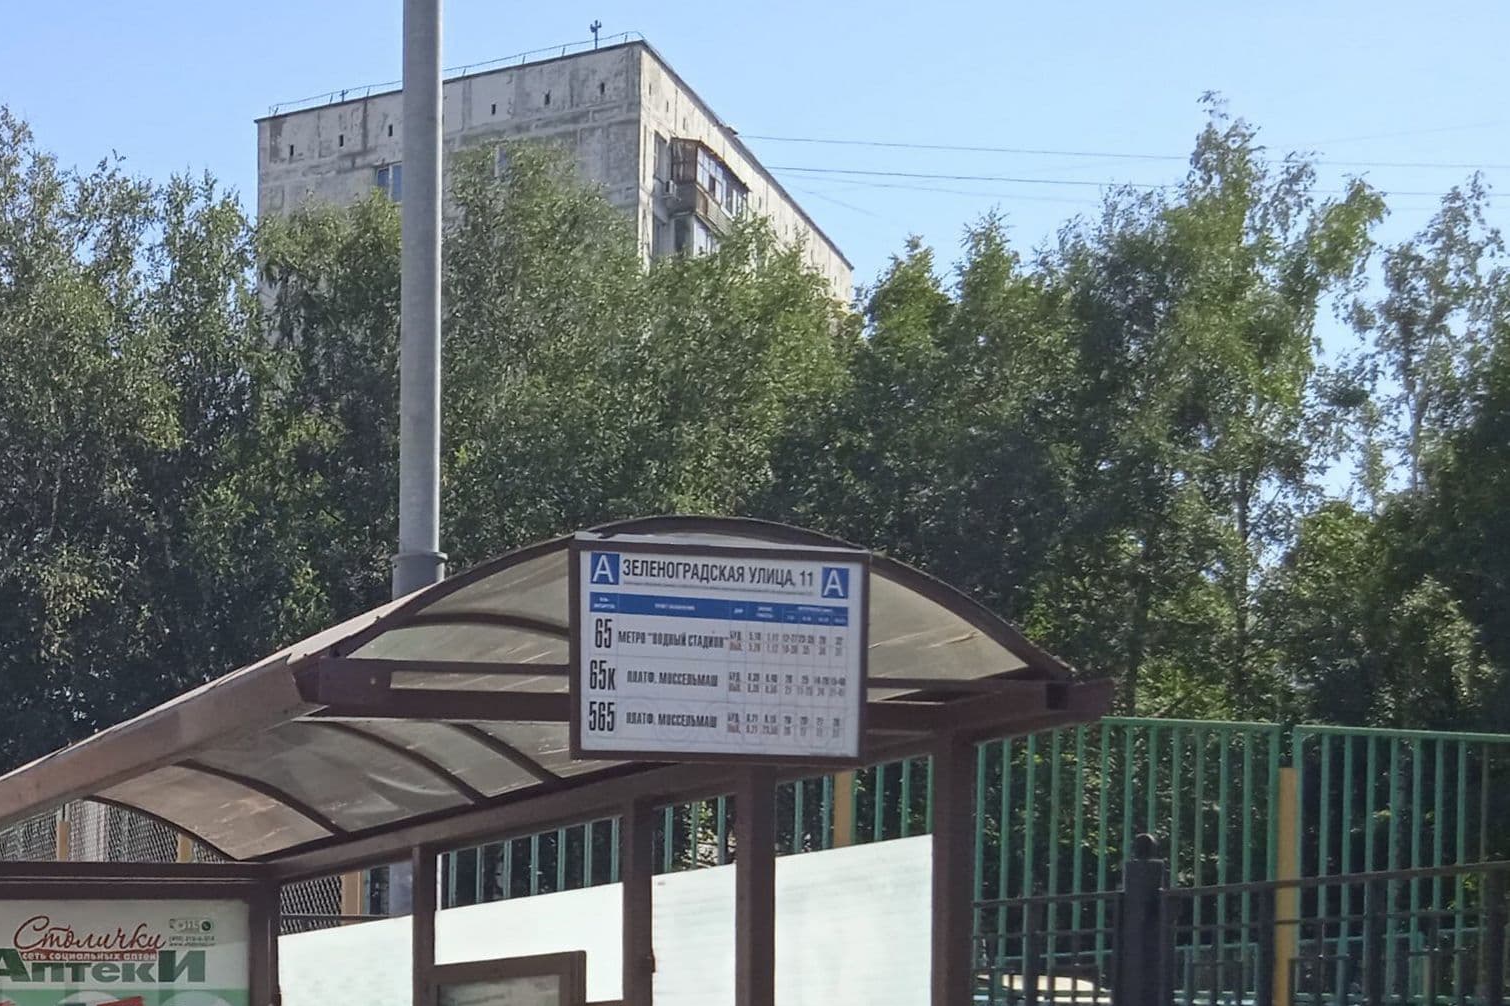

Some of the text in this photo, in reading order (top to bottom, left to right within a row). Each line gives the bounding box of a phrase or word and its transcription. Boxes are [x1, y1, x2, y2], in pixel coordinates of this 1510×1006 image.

[623, 559, 744, 584] ЗЕЛЕНОГРАДСКАЯ
[799, 570, 813, 587] 11
[595, 618, 613, 648] 65
[618, 631, 646, 644] МЕТРО
[589, 701, 615, 732] 565
[14, 916, 166, 950] Столички
[49, 951, 121, 962] социальных
